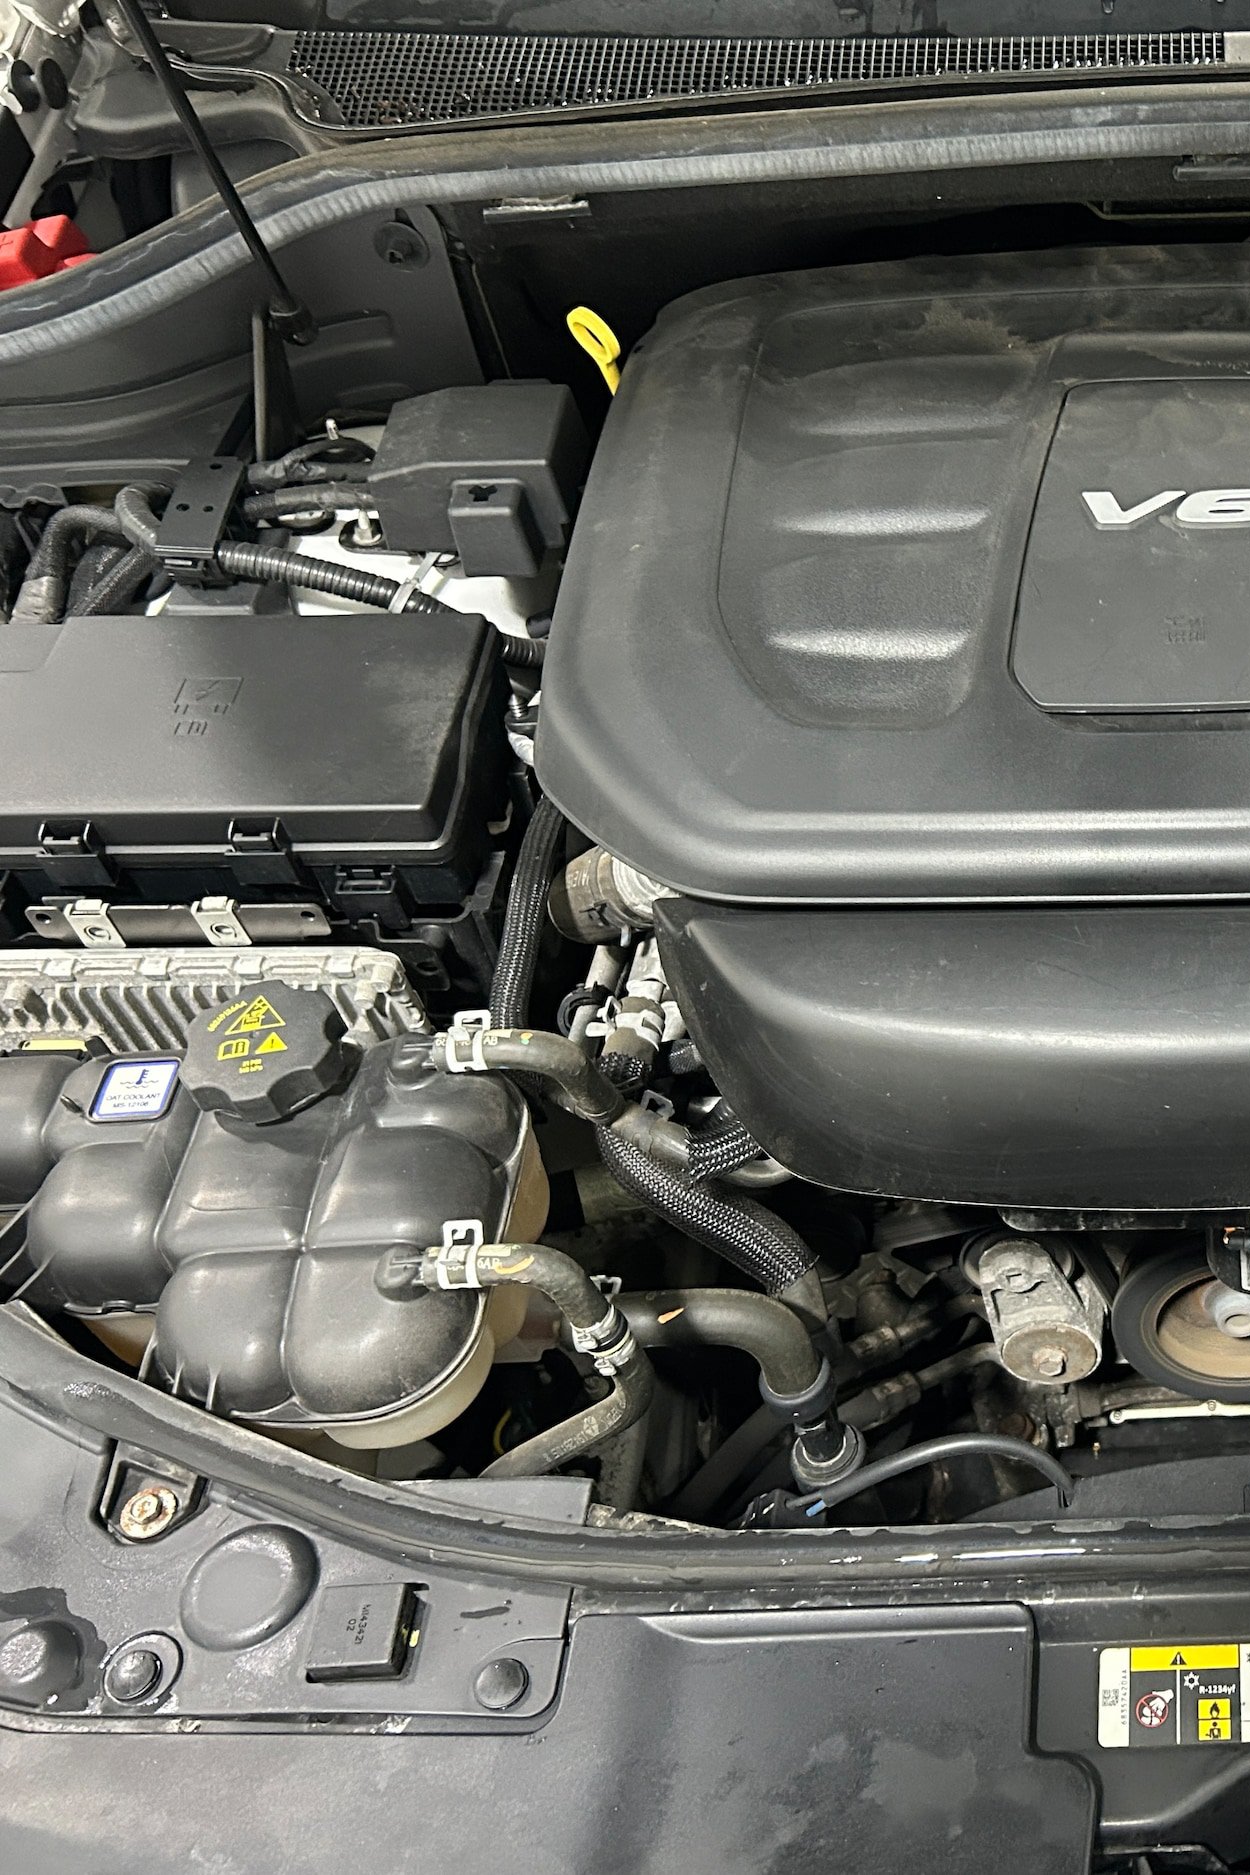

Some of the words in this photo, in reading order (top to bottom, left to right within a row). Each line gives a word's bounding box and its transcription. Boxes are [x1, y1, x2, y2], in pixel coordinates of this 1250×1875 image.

[123, 1092, 160, 1100] COOLANT
[346, 1618, 357, 1632] 02
[1199, 1684, 1236, 1695] R-1234yf
